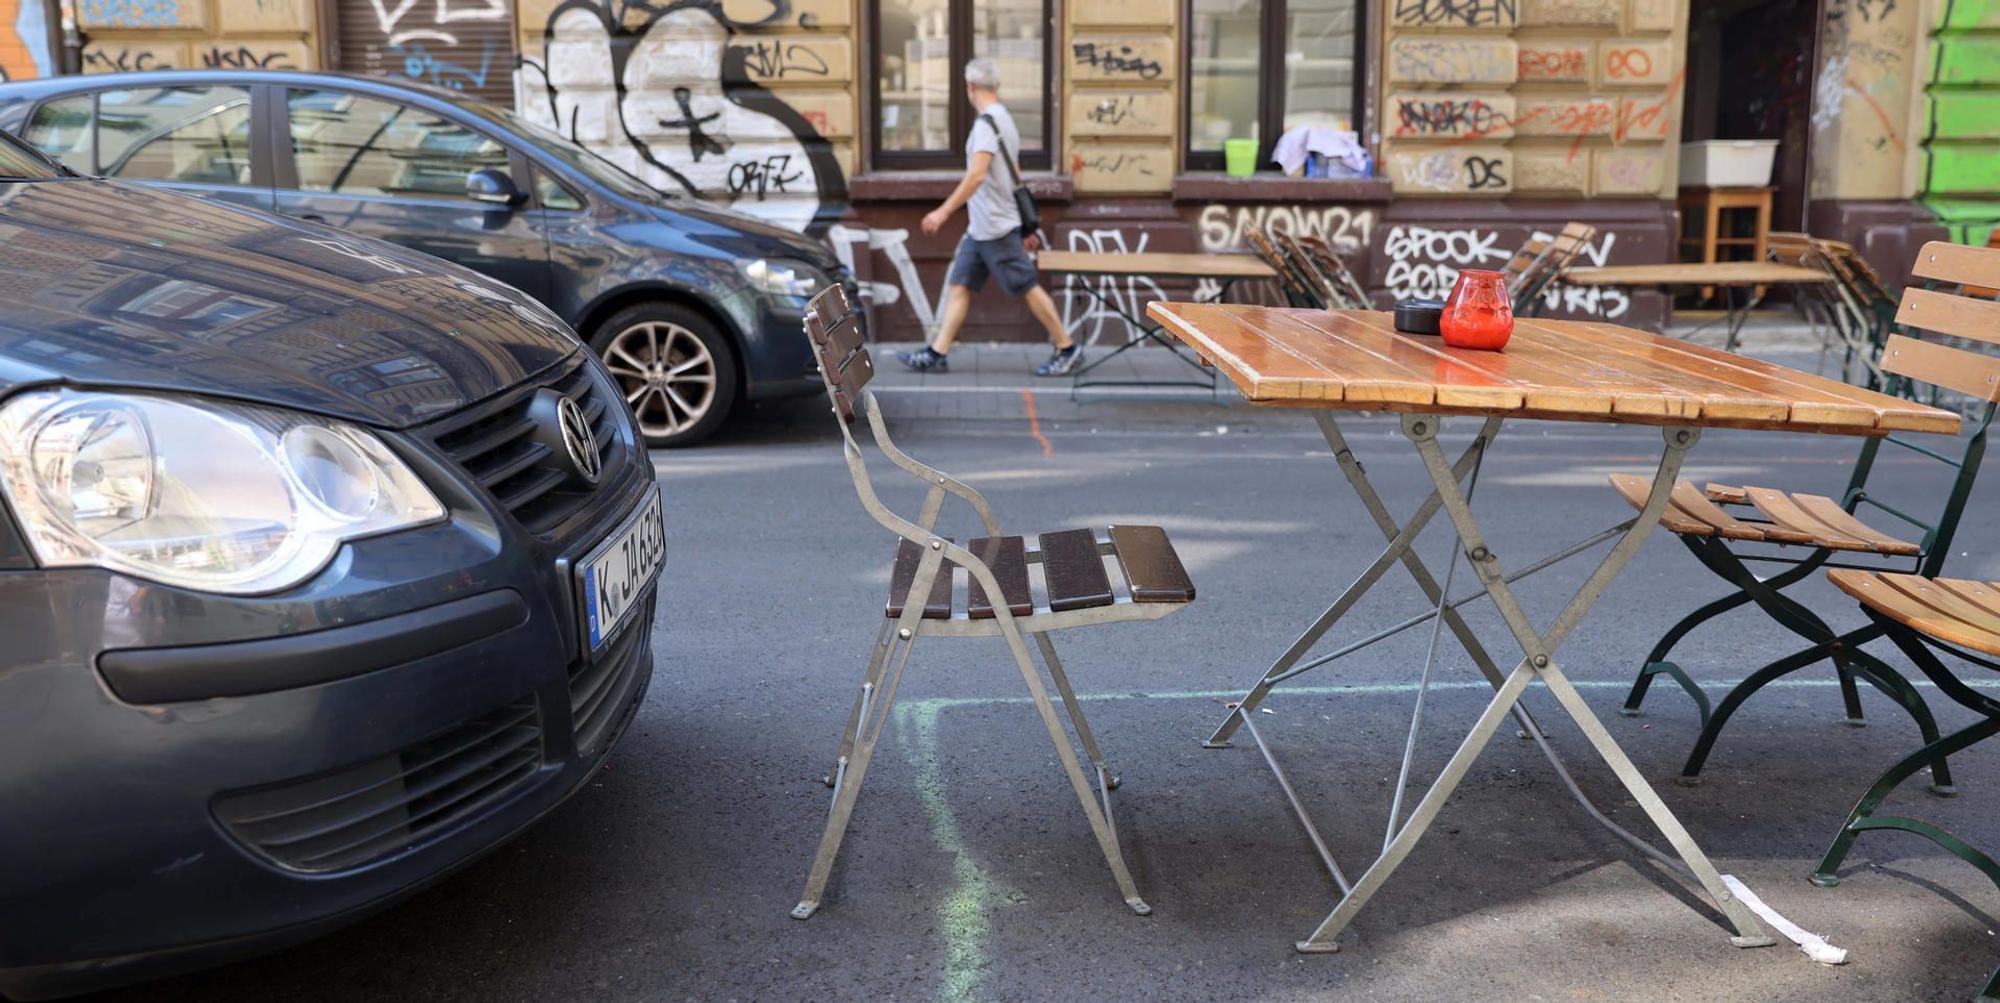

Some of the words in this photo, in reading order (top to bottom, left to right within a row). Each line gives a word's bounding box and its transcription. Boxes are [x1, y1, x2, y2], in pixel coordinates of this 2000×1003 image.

[1384, 226, 1513, 265] SPOOK
[598, 561, 613, 626] K
[621, 532, 639, 601] JA
